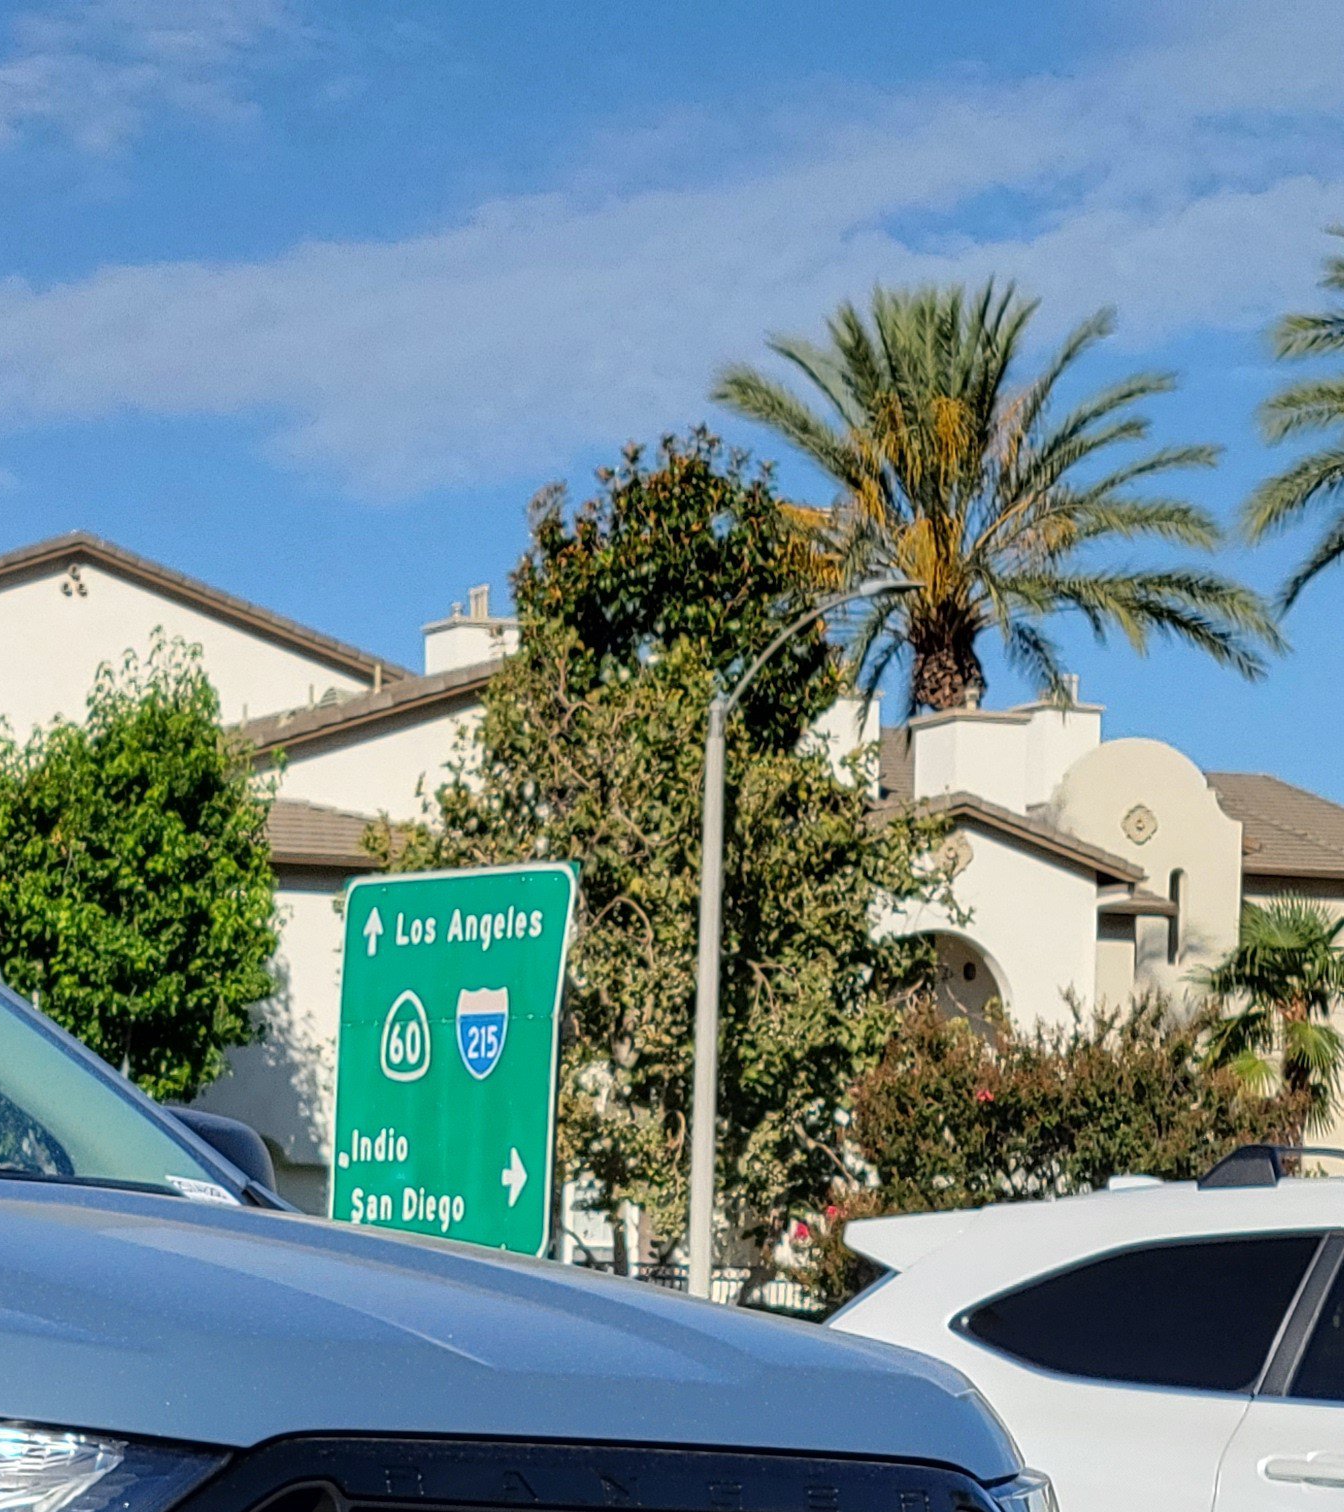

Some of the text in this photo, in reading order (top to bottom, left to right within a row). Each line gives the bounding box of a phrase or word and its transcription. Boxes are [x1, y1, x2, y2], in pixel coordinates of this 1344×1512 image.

[396, 905, 543, 951] Los Angeles
[388, 1021, 422, 1066] 60
[467, 1024, 500, 1061] 215
[351, 1127, 409, 1163] Indio
[350, 1187, 465, 1232] San Diego
